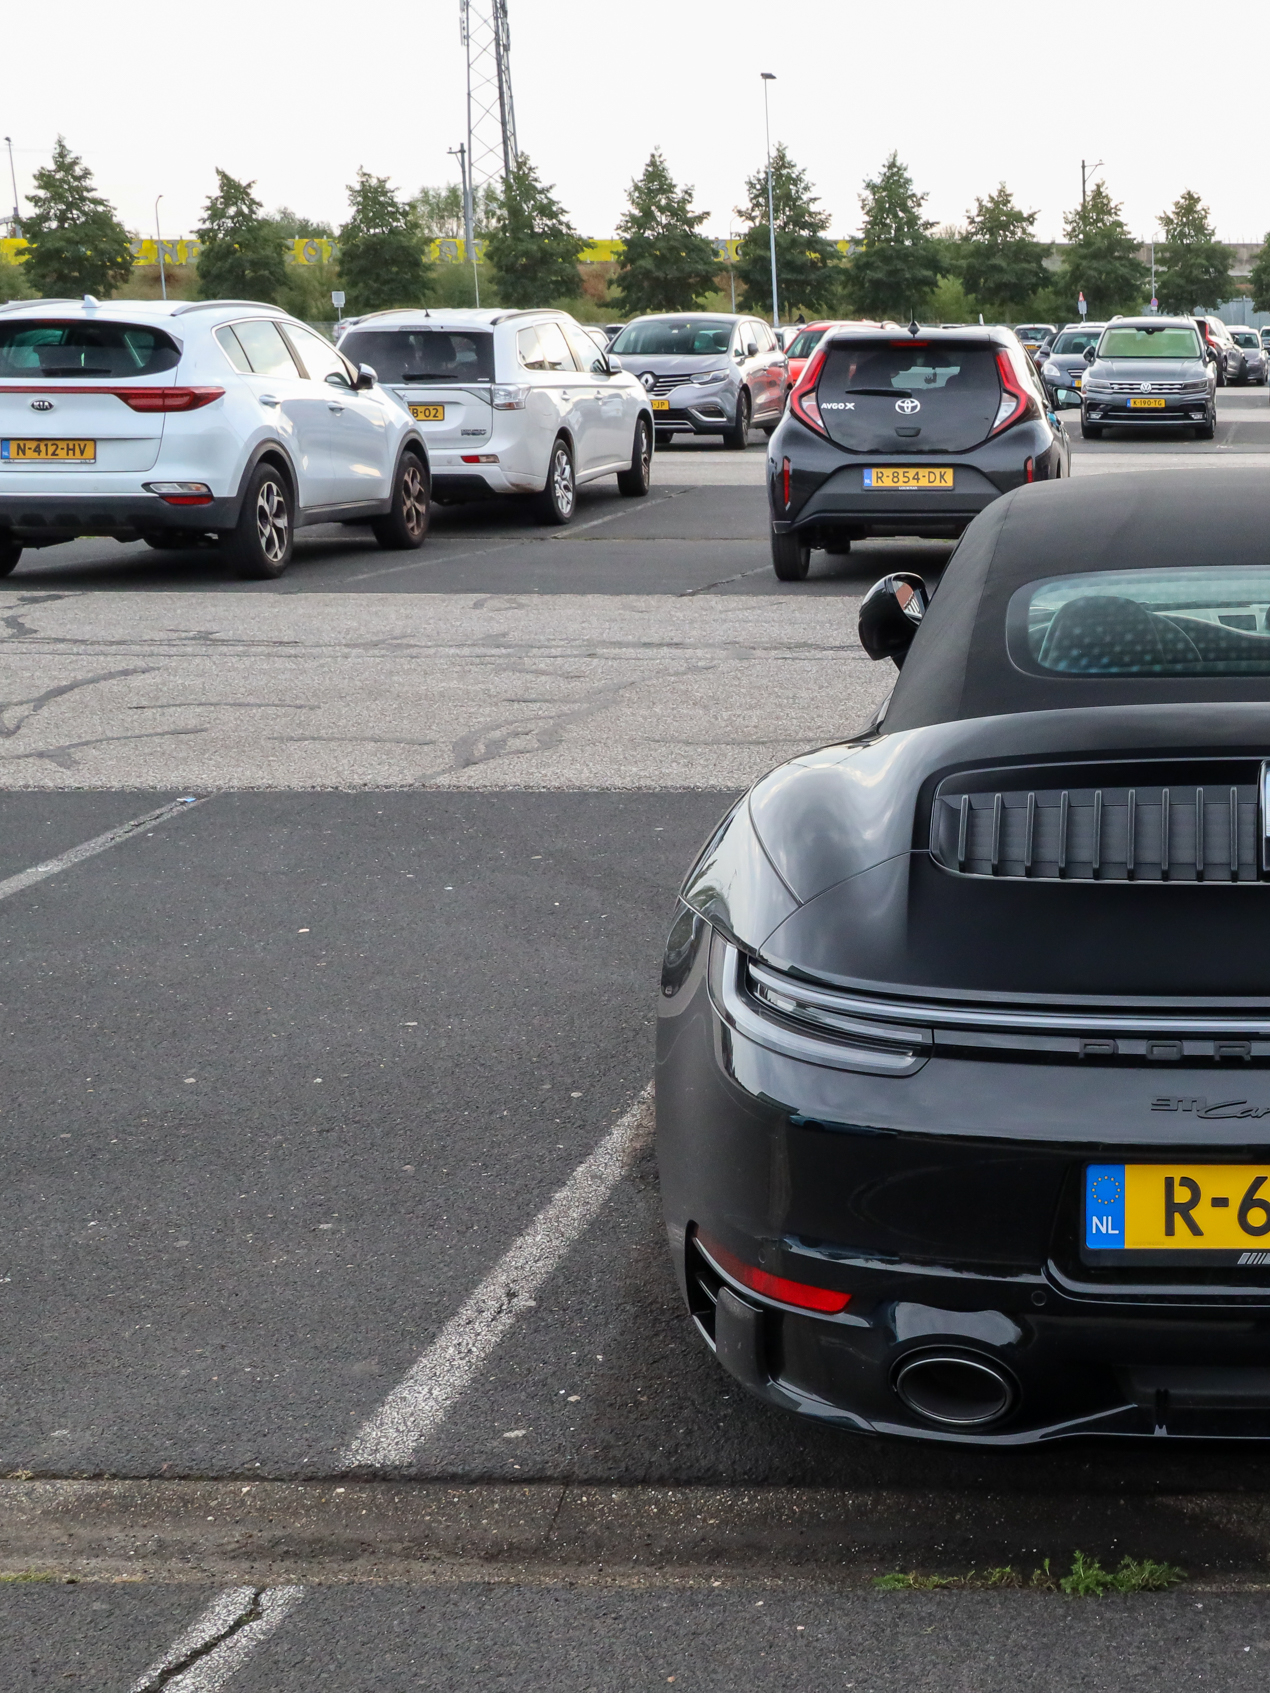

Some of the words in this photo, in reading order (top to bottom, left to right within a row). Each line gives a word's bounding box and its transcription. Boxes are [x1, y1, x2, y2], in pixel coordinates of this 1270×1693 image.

[33, 401, 51, 409] KIA
[821, 402, 844, 410] AYGO
[845, 402, 855, 410] X
[16, 443, 87, 456] N-412-HV
[876, 471, 948, 484] R-854-DK
[1151, 1095, 1207, 1112] 911
[1092, 1215, 1119, 1234] NL
